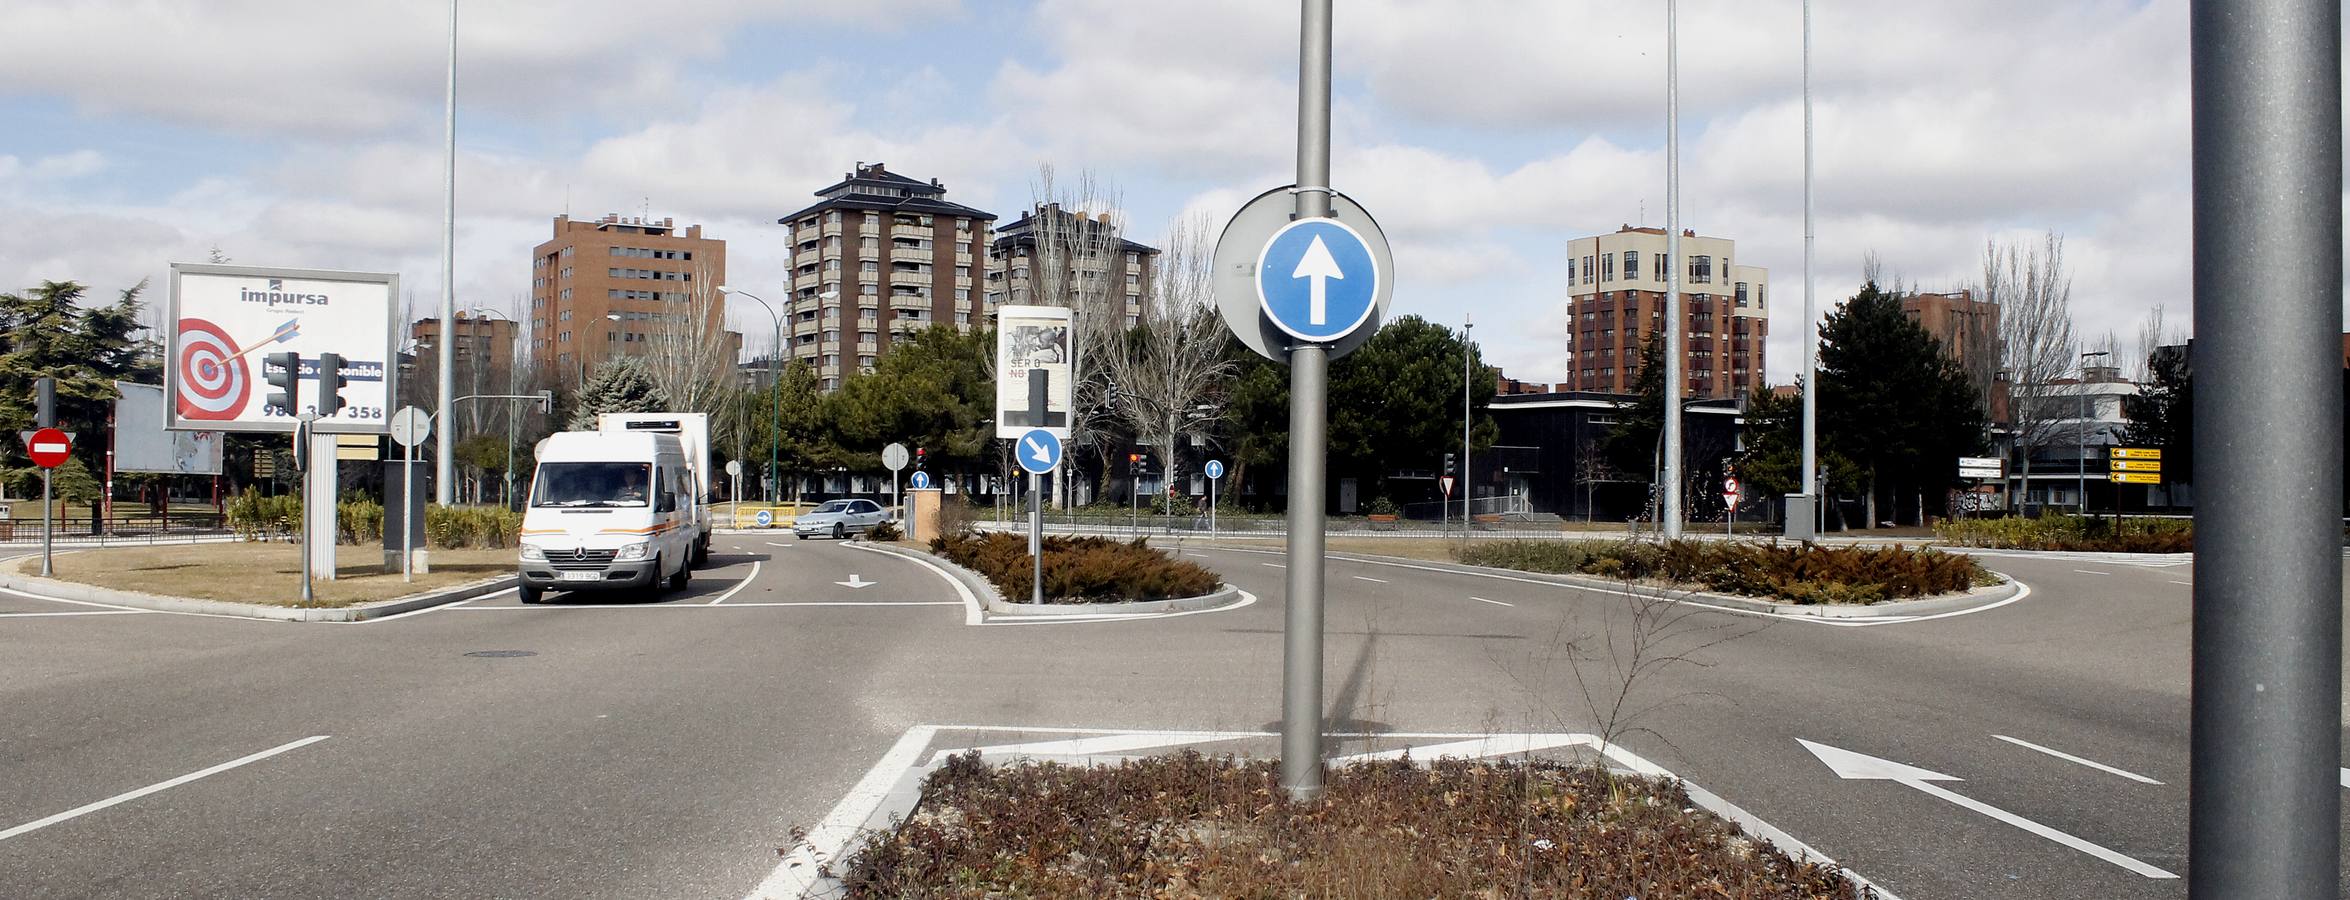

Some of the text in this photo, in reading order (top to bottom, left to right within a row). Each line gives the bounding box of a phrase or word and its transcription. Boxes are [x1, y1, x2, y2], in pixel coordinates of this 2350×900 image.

[241, 287, 329, 306] impursa
[1011, 359, 1031, 368] SER
[348, 406, 382, 419] 358
